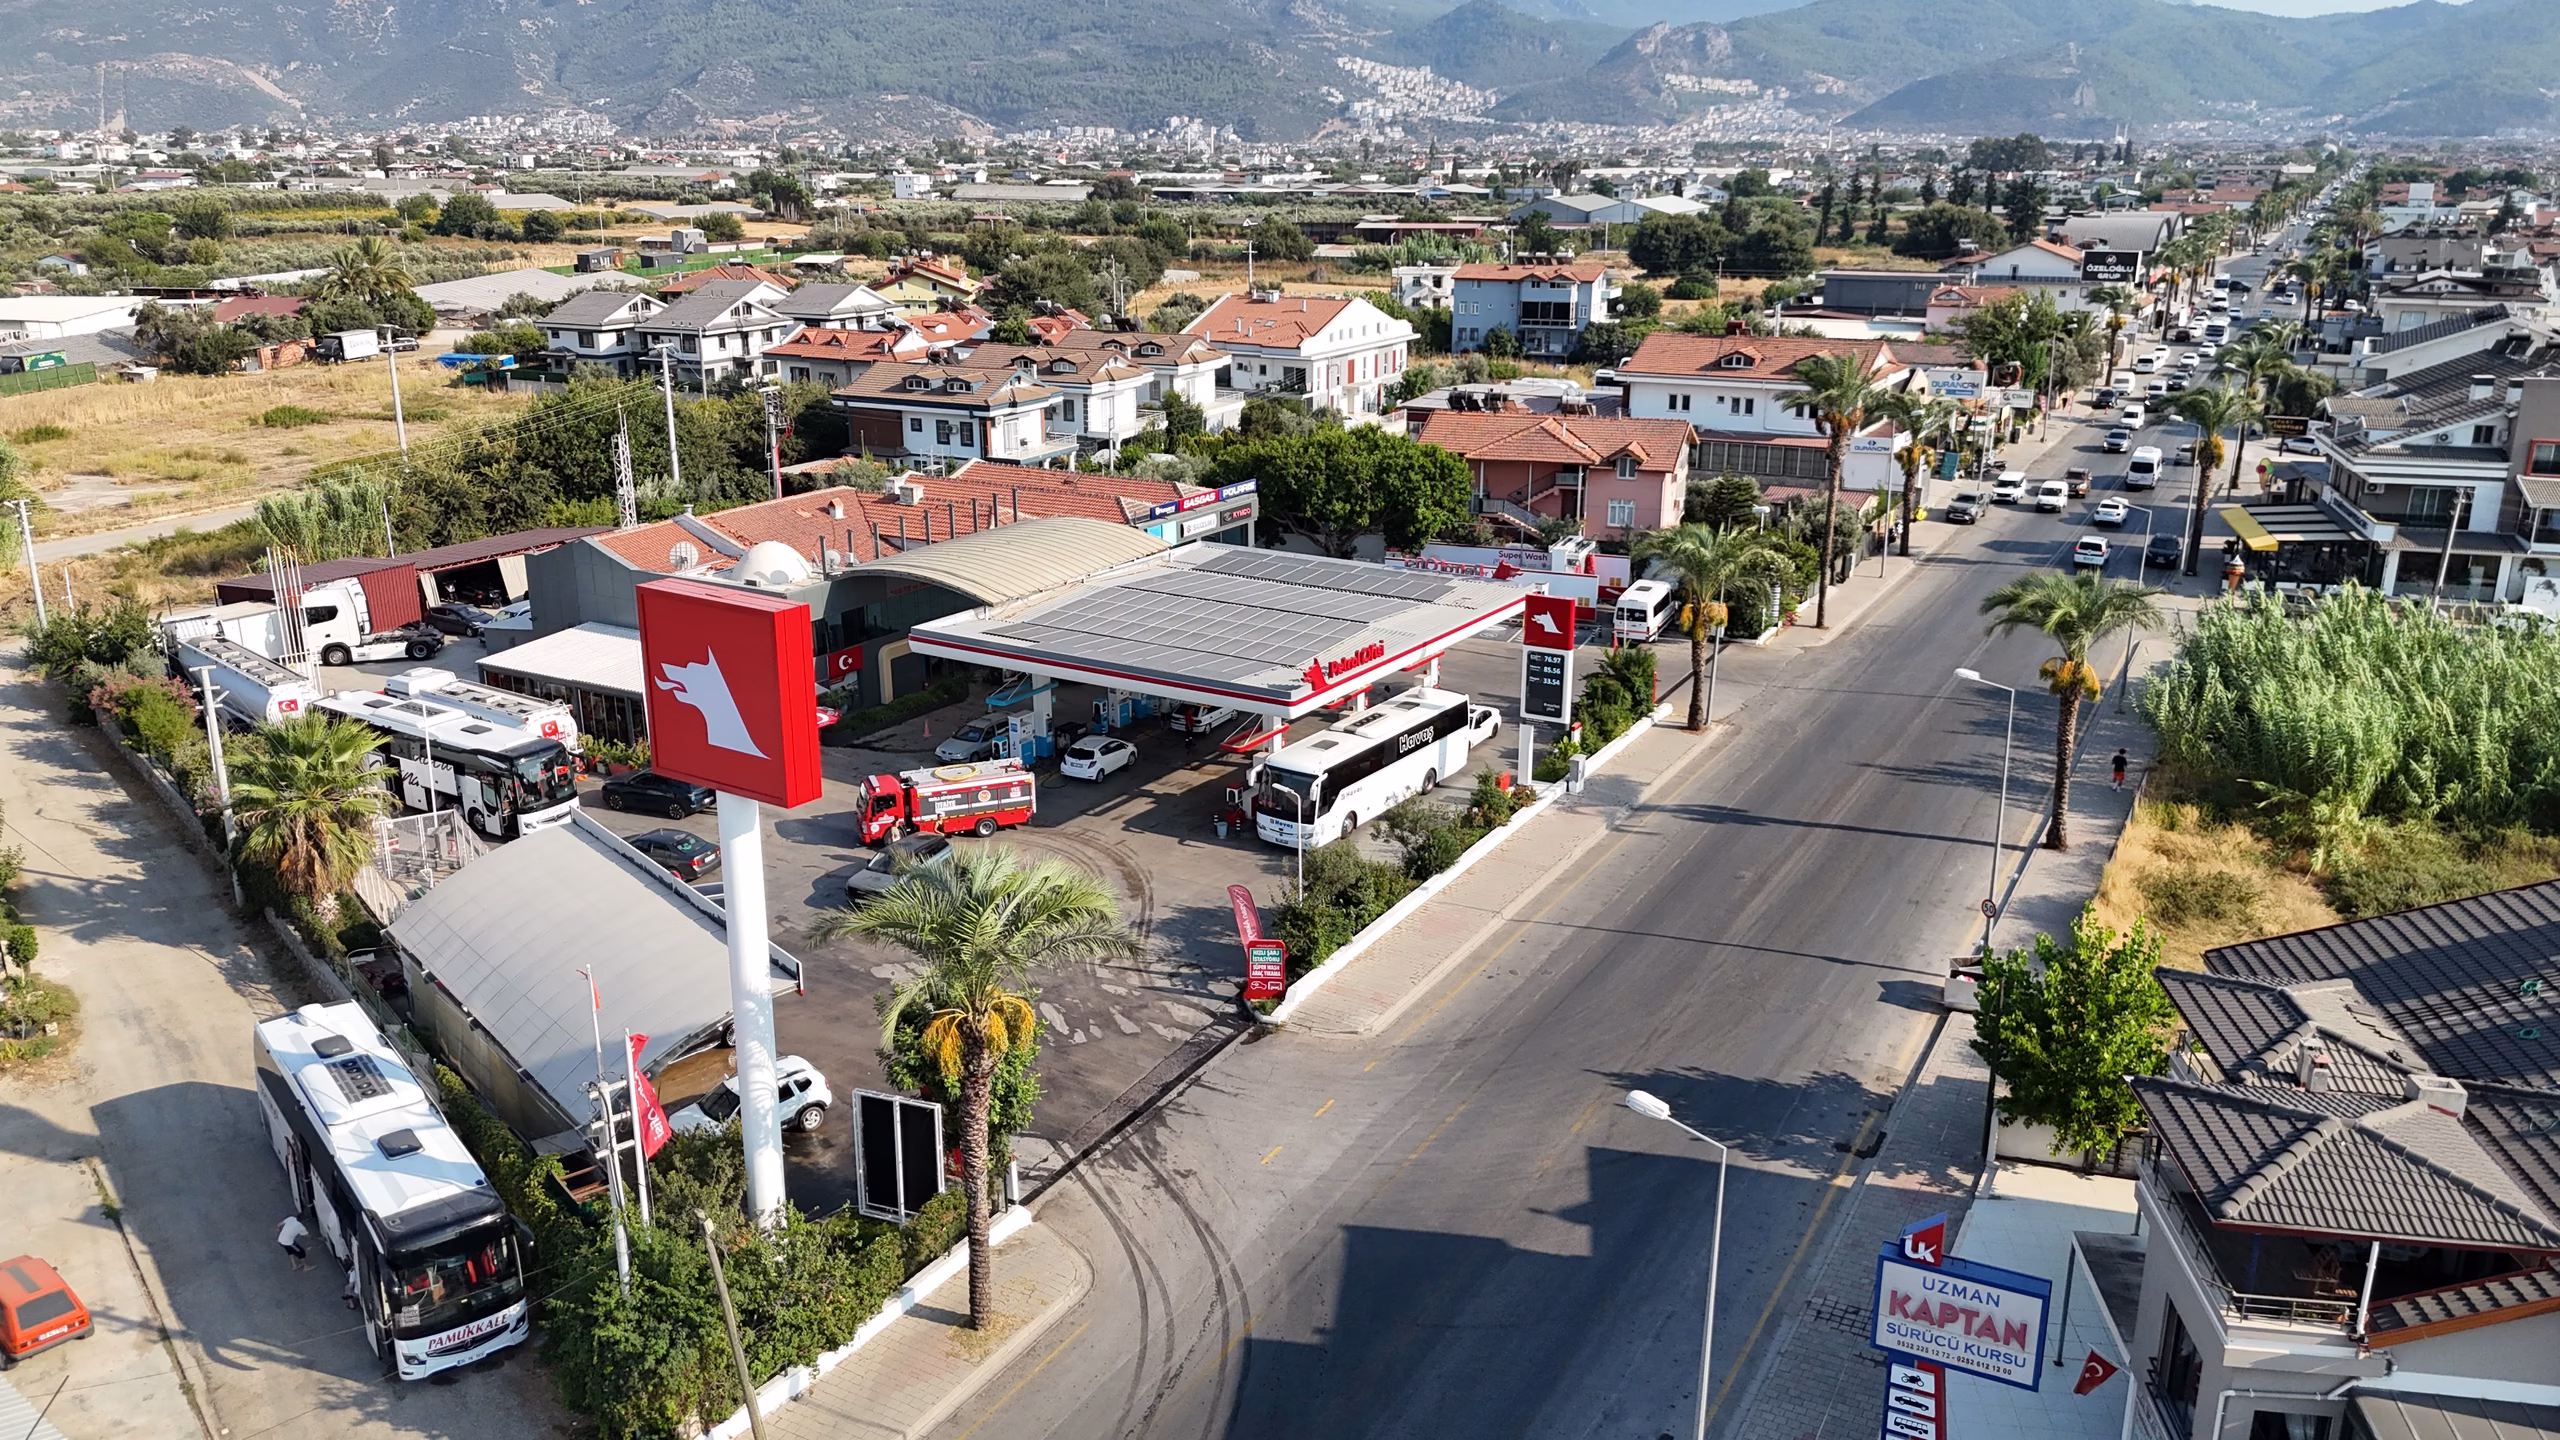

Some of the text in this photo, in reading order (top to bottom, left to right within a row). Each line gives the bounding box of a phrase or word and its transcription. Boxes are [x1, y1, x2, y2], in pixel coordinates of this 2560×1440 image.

[2086, 263, 2134, 273] ÖZELOĞLU
[1222, 481, 1256, 498] POLARIS
[1183, 492, 1216, 509] GASGAS
[1233, 507, 1251, 519] KYMCO
[1193, 517, 1216, 531] SUZUKI
[1498, 550, 1548, 561] Super Wash
[1544, 655, 1561, 664] 76.97
[1543, 666, 1561, 675] 85.56
[1543, 677, 1560, 686] 33.54
[1399, 726, 1435, 754] Havaş
[1984, 903, 1993, 914] 50
[1922, 1275, 2000, 1308] UZMAN
[1888, 1289, 2028, 1351] KAPTAN
[427, 1312, 508, 1350] PAMUKKALE
[1885, 1321, 2026, 1369] SÜRÜCÜ KURSU
[1931, 1347, 1940, 1357] 12
[1941, 1350, 1951, 1359] 72
[1976, 1359, 1990, 1372] 612
[1992, 1363, 2001, 1373] 12
[2002, 1366, 2012, 1376] 00
